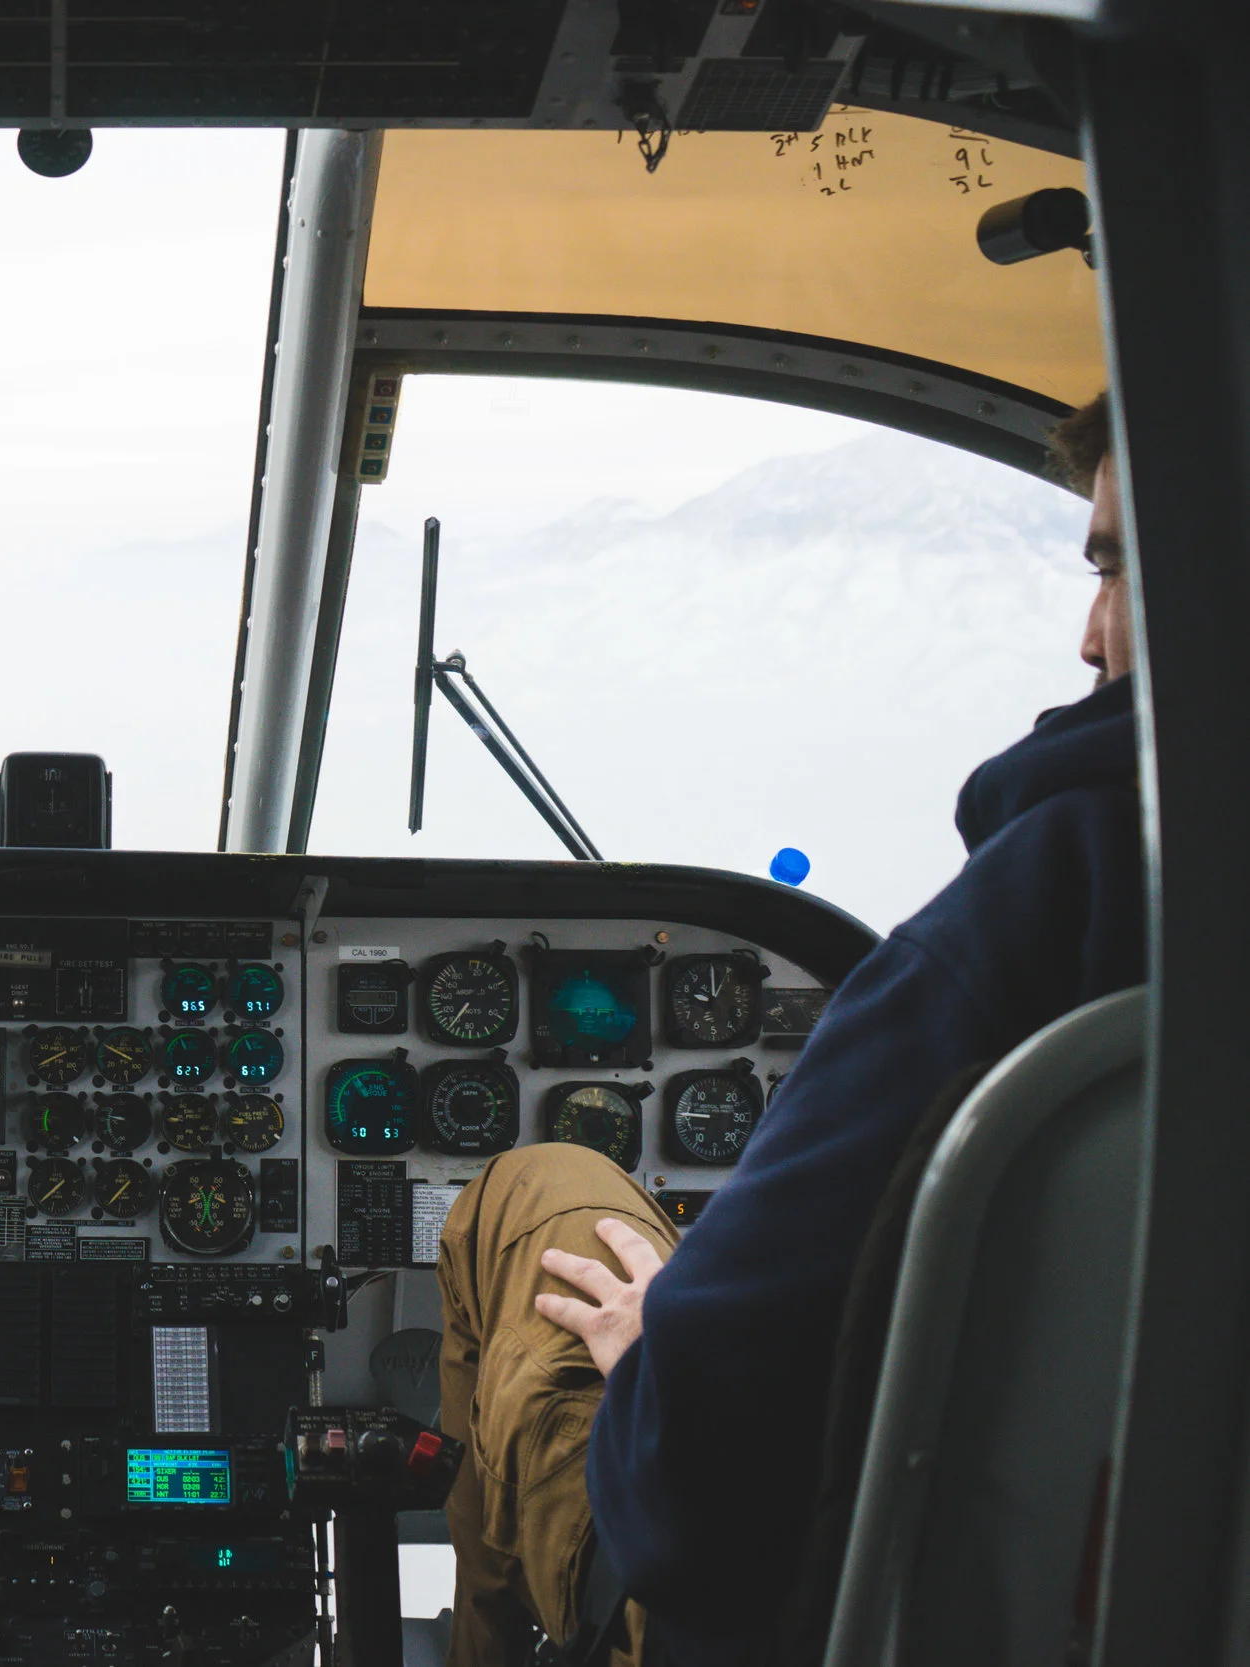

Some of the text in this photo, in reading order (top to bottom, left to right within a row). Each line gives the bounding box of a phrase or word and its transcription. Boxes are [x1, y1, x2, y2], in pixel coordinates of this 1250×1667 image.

[352, 949, 388, 957] CAL 1990
[684, 984, 690, 993] 8
[694, 1021, 700, 1030] 6
[710, 1026, 718, 1035] 5
[176, 1066, 200, 1076] 627
[241, 1066, 266, 1076] 627
[698, 1092, 706, 1101] 10
[726, 1092, 738, 1102] 20
[734, 1113, 746, 1123] 30
[352, 1128, 368, 1138] 50
[384, 1128, 400, 1138] 53
[696, 1133, 704, 1143] 10
[724, 1132, 737, 1142] 20
[312, 1351, 319, 1361] F
